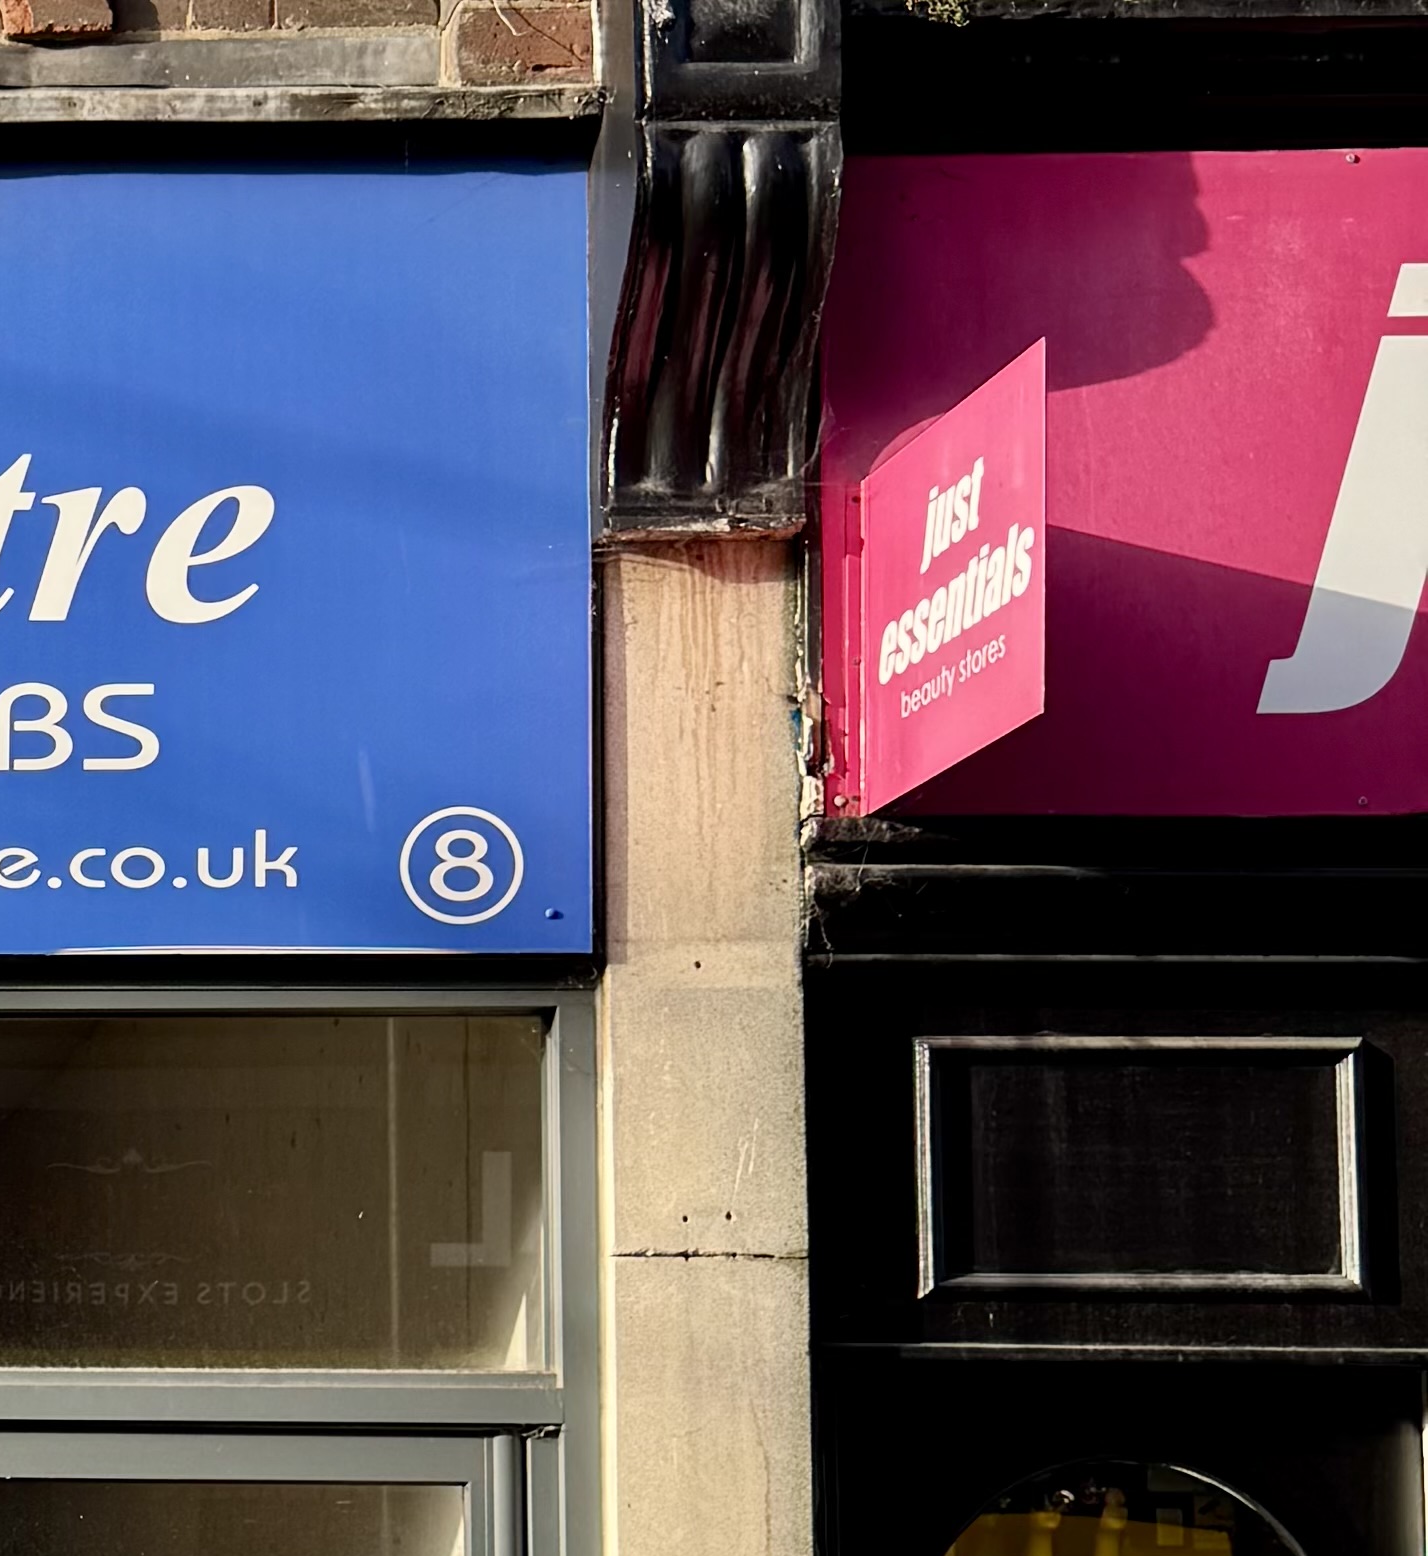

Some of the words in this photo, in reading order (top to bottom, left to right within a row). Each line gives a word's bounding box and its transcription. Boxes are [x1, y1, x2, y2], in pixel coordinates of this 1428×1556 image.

[920, 456, 984, 575] just
[878, 523, 1035, 685] essentials
[900, 662, 955, 719] beauty
[958, 632, 1006, 684] stores
[431, 835, 490, 894] 8
